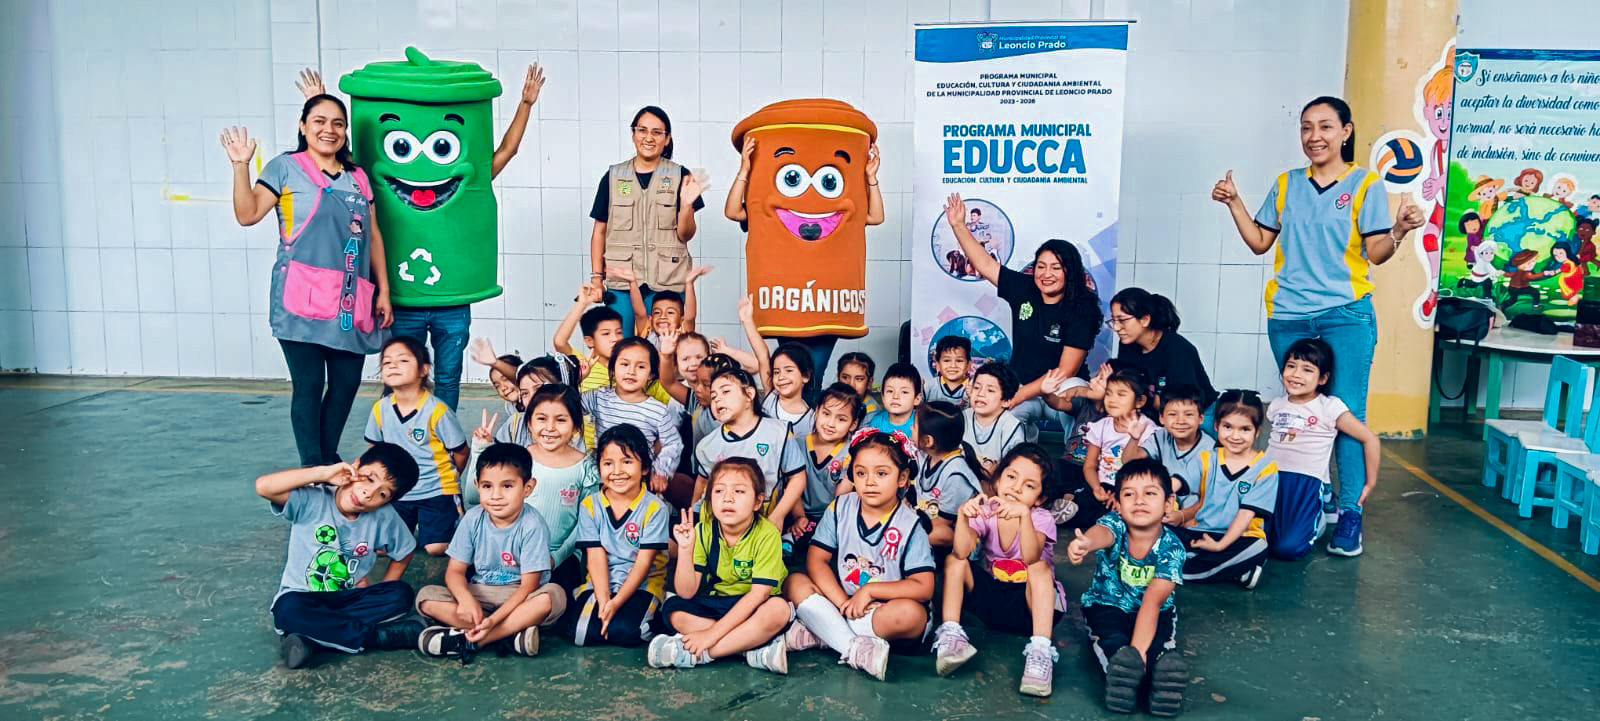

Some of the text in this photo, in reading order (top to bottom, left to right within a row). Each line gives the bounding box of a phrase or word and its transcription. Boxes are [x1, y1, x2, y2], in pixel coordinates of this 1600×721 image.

[999, 40, 1066, 50] Leoncio Prado
[1476, 69, 1492, 87] Si
[1493, 71, 1547, 83] enseñamos
[1550, 74, 1558, 83] a
[1560, 69, 1575, 84] los
[1460, 94, 1600, 112] aceptar la diversidad como
[943, 123, 1092, 138] PROGRAMA MUNICIPAL
[1456, 119, 1496, 135] normal,
[1498, 124, 1512, 134] no
[1514, 122, 1537, 135] será
[1538, 123, 1587, 136] necesario
[943, 138, 1087, 175] EDUCCA
[1456, 145, 1469, 159] de
[1521, 148, 1541, 161] sino
[1544, 147, 1557, 161] de
[979, 176, 1005, 184] CULTURA
[1006, 176, 1011, 184] Y
[1053, 176, 1089, 184] AMBIENTAL
[758, 279, 866, 315] ORGÁNICOS
